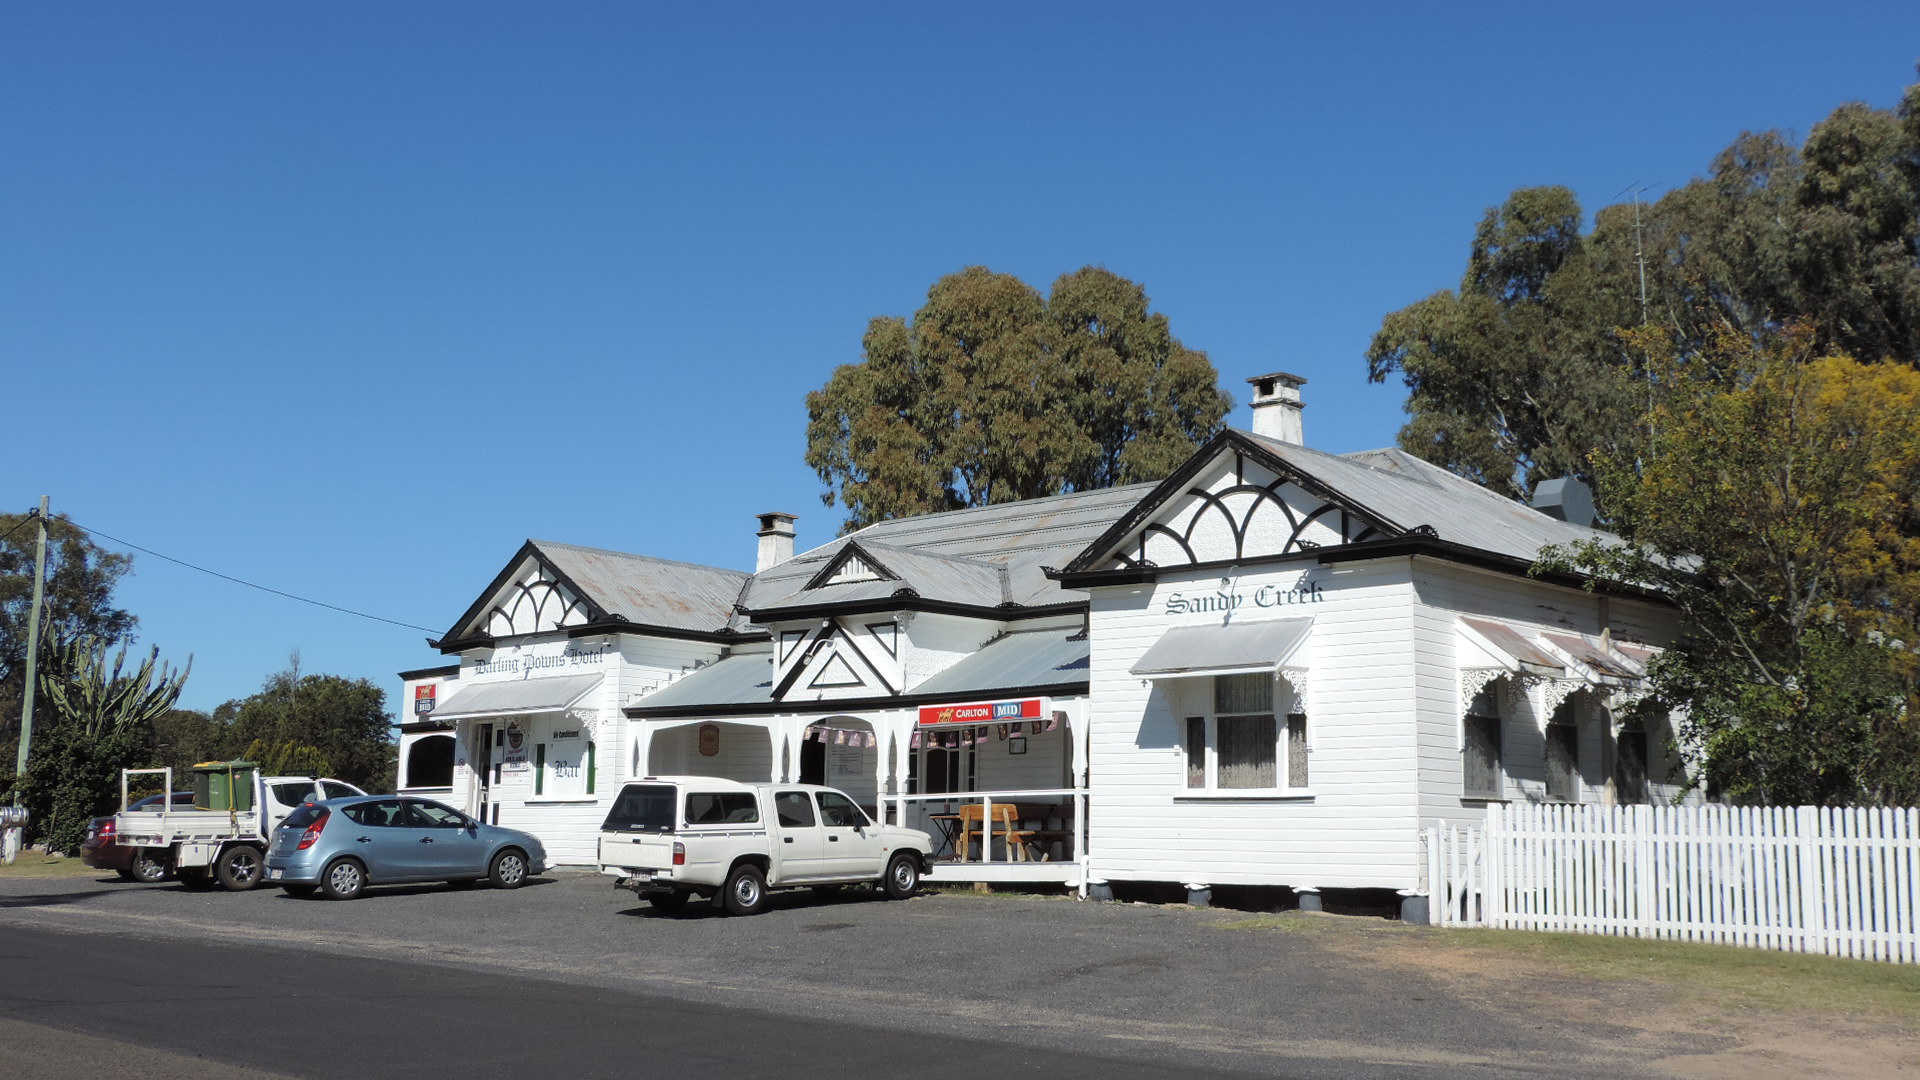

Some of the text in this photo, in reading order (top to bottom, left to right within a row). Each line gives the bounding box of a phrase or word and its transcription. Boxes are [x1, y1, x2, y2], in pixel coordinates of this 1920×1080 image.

[1165, 580, 1324, 615] Sandy Creek
[474, 647, 603, 676] Darling Downs Hotel
[955, 704, 1018, 719] CARLTON MID
[554, 760, 579, 780] Bar
